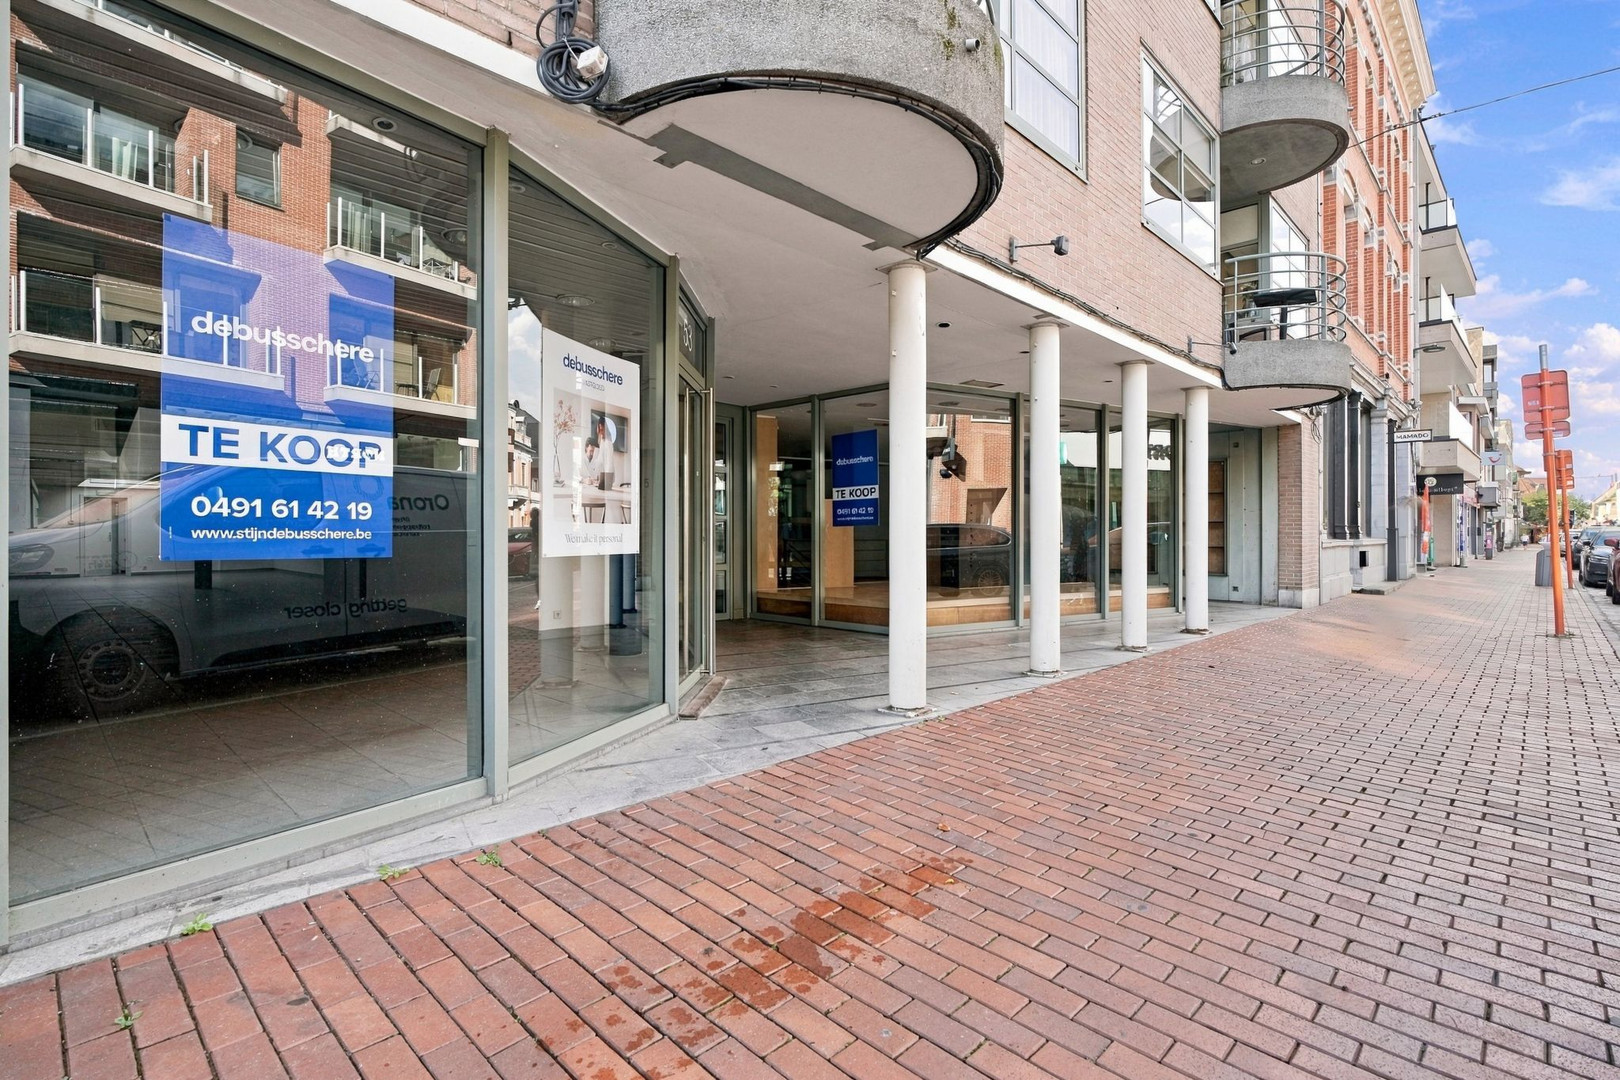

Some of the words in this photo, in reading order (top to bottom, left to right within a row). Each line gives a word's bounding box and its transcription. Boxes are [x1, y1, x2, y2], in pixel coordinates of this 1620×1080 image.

[191, 311, 375, 363] debusschere
[683, 318, 693, 352] 53
[562, 352, 623, 386] debusschere
[178, 423, 240, 459] TE
[259, 431, 382, 468] KOOP
[190, 496, 262, 518] 0491
[271, 499, 299, 519] 61
[307, 500, 339, 520] 42
[346, 502, 372, 520] 19
[835, 489, 846, 499] TE
[848, 487, 877, 498] KOOP
[191, 527, 372, 542] www.stijndebusschere.be
